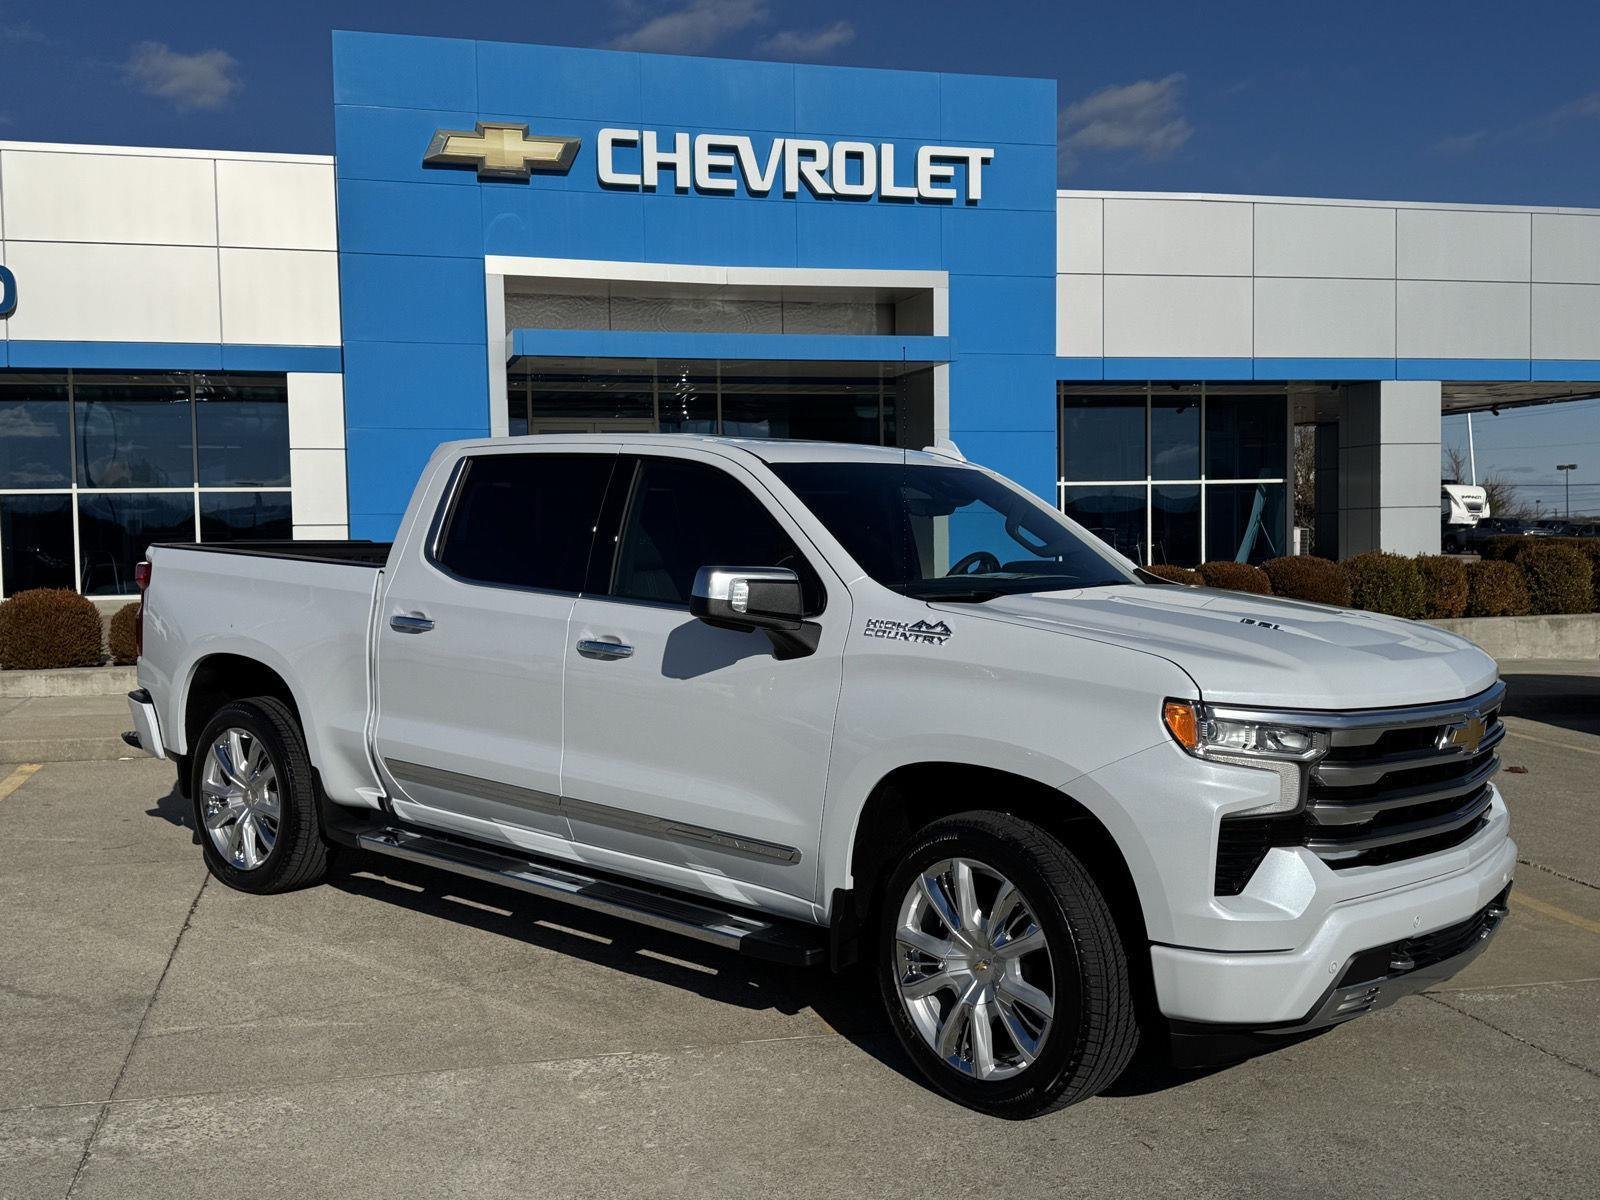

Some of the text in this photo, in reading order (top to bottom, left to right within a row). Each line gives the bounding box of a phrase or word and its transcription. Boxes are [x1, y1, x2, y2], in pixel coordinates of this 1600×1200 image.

[597, 128, 995, 201] CHEVROLET
[866, 618, 909, 631] HIGH
[863, 628, 950, 645] COUNTRY
